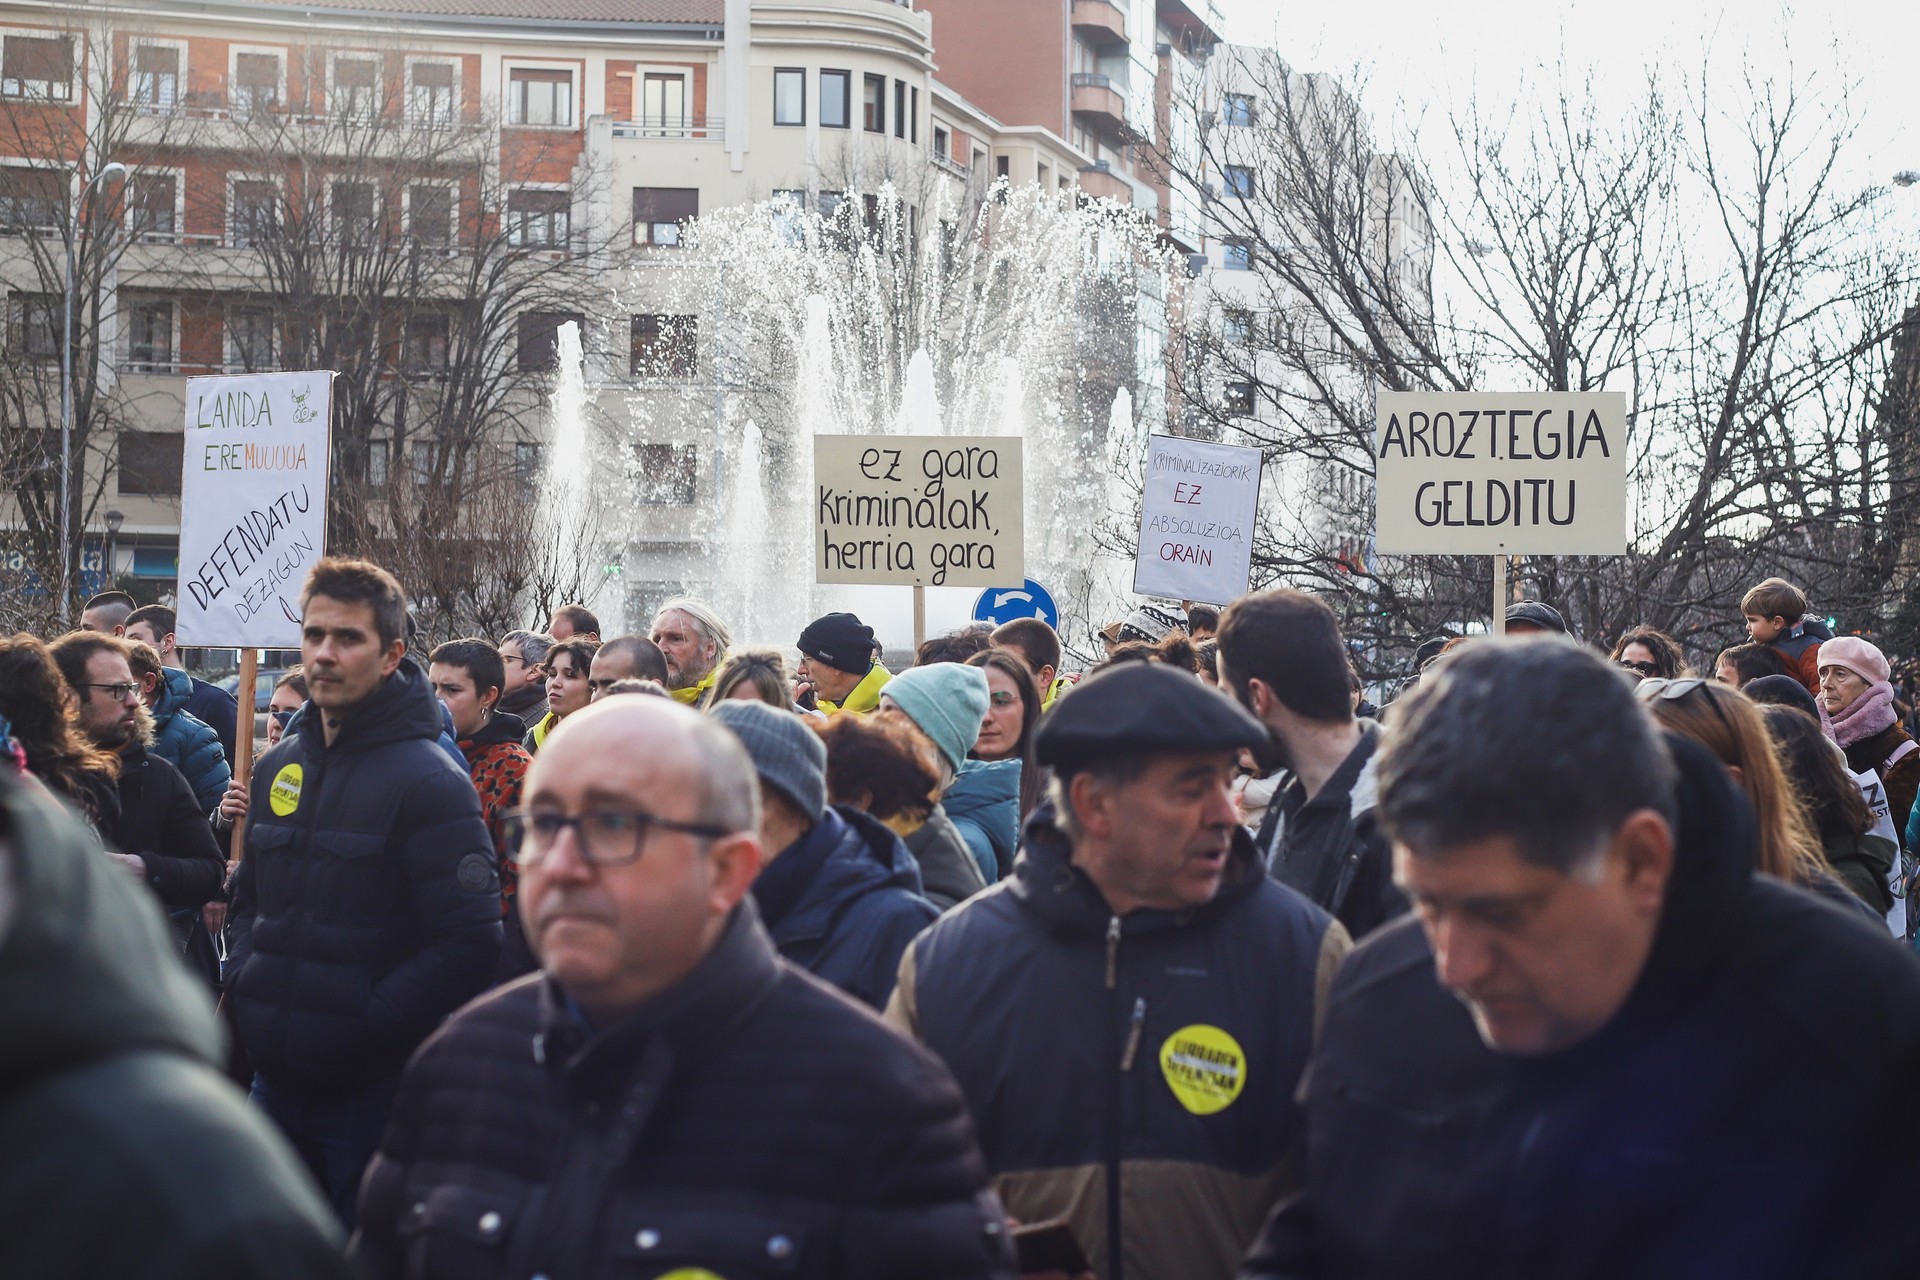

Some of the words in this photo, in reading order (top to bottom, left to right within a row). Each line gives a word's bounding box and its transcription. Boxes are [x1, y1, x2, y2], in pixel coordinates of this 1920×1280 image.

[197, 390, 272, 429] LANDA
[1379, 408, 1610, 460] AROZTEGIA
[859, 448, 902, 482] ez
[922, 446, 999, 497] gara
[1173, 481, 1203, 505] EZ
[1414, 479, 1576, 526] GELDITU
[187, 483, 310, 612] DEFENDATU
[1148, 515, 1243, 541] ABSOLUZIOA
[234, 530, 313, 624] DEZAGUN
[824, 529, 915, 571] herria
[930, 542, 996, 586] gara
[1159, 542, 1212, 567] ORAIN
